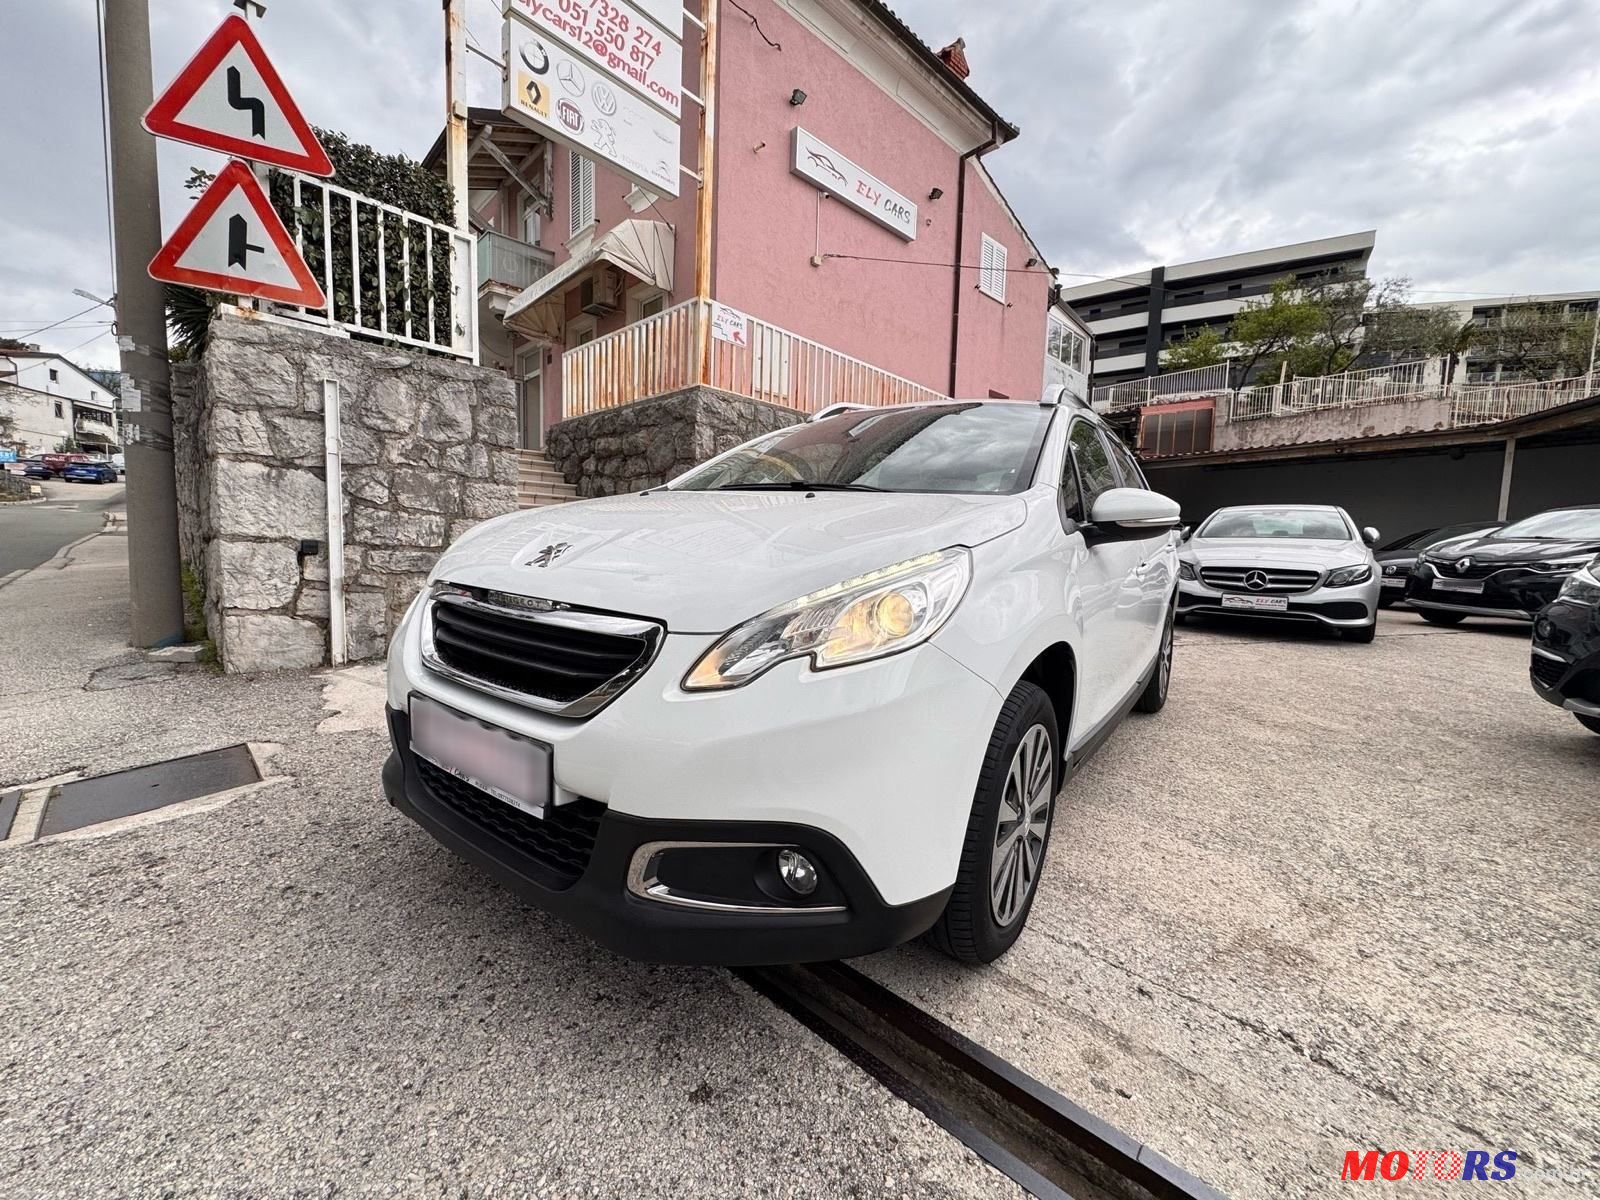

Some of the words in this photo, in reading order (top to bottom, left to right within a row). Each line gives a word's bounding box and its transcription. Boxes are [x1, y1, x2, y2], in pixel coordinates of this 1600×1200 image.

[559, 0, 588, 26] 051
[594, 19, 625, 51] 550
[630, 45, 654, 70] 817
[634, 26, 662, 57] 274
[562, 106, 579, 128] FIAT
[856, 180, 881, 206] ELY
[884, 198, 911, 225] CARS
